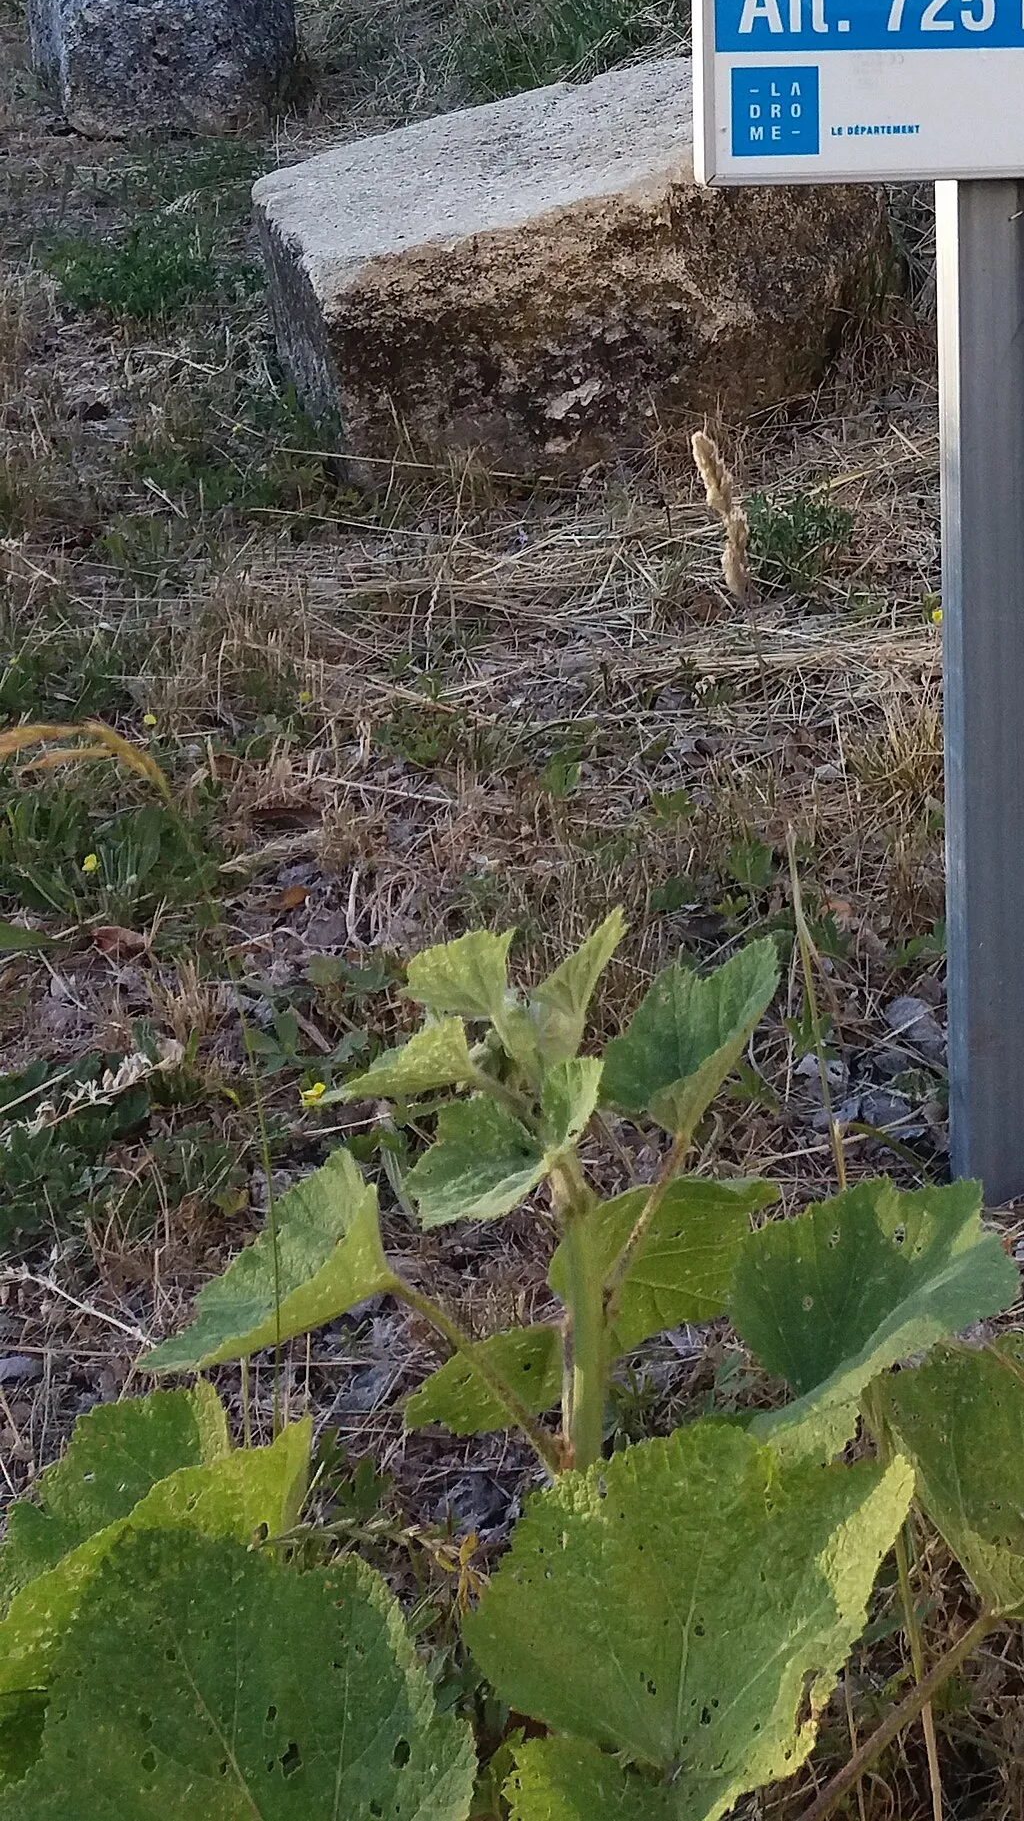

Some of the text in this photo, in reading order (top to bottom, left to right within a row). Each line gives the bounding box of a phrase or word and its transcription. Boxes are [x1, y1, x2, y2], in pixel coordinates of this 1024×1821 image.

[749, 103, 801, 119] DRO
[831, 124, 921, 136] LE DÉPARTEMENT
